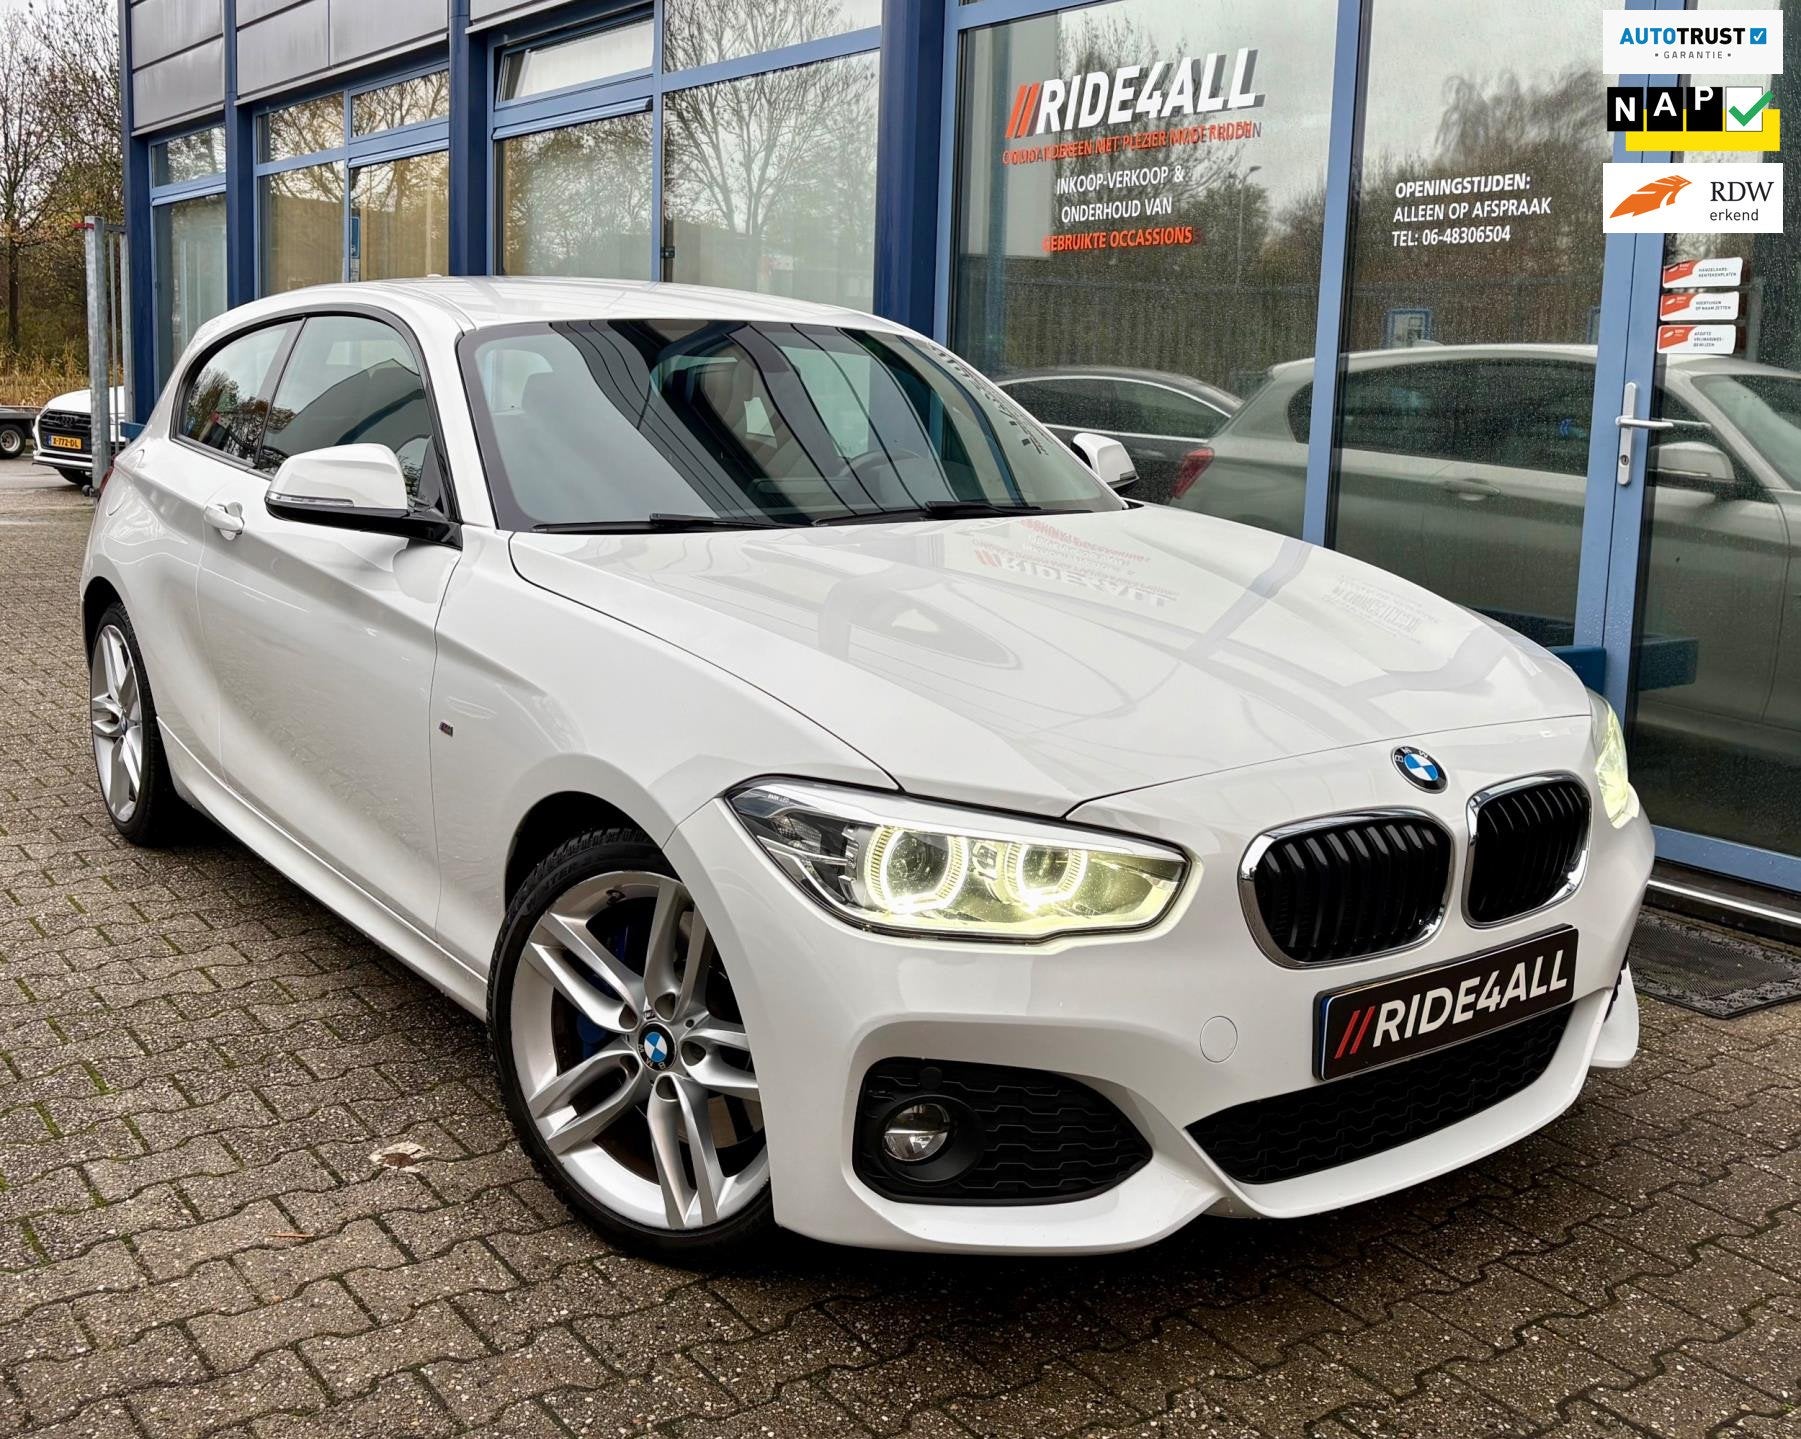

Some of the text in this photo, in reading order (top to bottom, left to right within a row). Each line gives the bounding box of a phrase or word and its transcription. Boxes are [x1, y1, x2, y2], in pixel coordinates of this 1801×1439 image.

[1056, 164, 1186, 194] INKOOP-VERKOOP &
[1395, 172, 1531, 198] OPENINGSTIJDEN:
[1061, 197, 1173, 223] ONDERHOUD VAN
[1393, 197, 1552, 223] ALLEEN OP AFSPRAAK
[1042, 226, 1193, 253] GEBRUIKTE OCCASSIONS
[1392, 225, 1511, 247] TEL: 06-48306504
